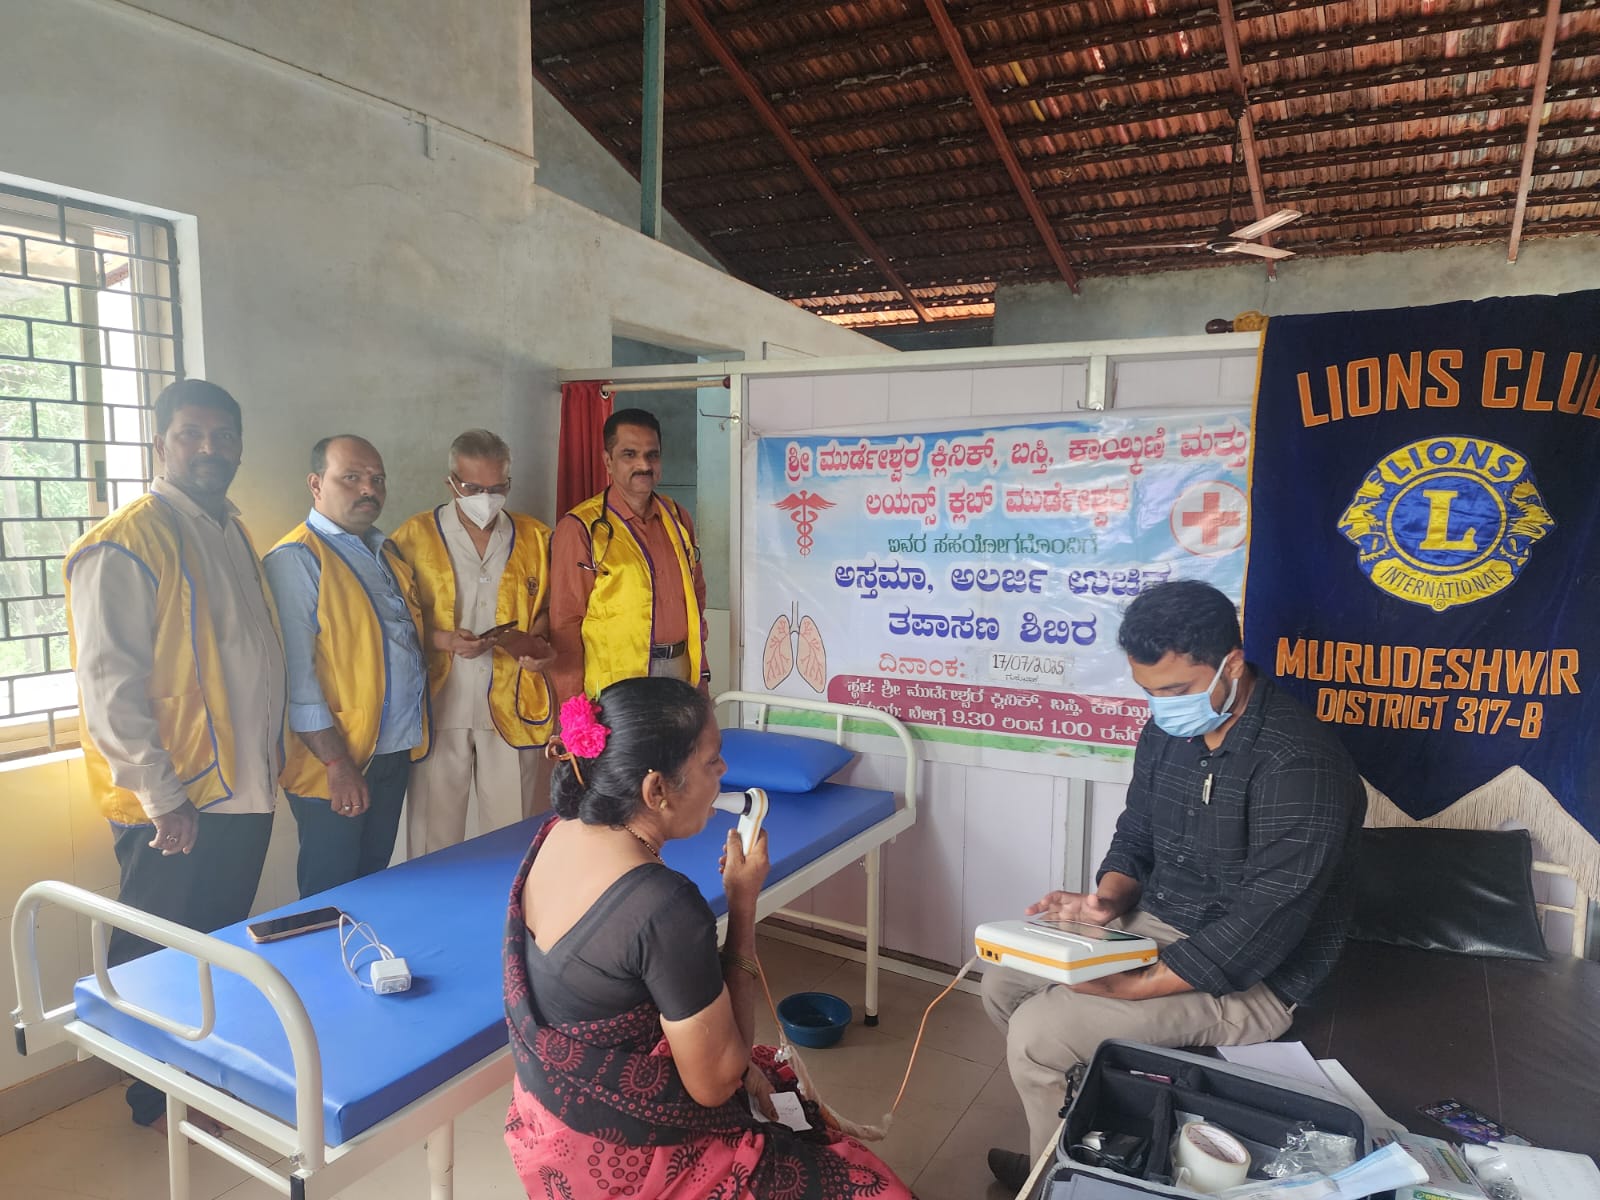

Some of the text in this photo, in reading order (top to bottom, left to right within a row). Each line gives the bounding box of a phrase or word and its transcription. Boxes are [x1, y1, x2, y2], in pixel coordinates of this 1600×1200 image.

[1296, 349, 1463, 428] LIONS
[787, 446, 810, 482] ಶ್ರೀ
[1011, 440, 1054, 474] ಬಸ್ತಿ,
[1181, 424, 1247, 468] ಮತ್ತು
[1384, 440, 1517, 480] LIONS
[866, 486, 936, 525] ಲಯನ್ಸ್
[949, 485, 993, 524] ಕ್ಲಬ್
[1420, 489, 1477, 552] L
[1380, 566, 1506, 599] INTERNATIONAL
[1020, 612, 1097, 646] ಶಿಬಿರ
[992, 654, 1065, 676] 17/07/2025
[1276, 637, 1581, 695] MURUDESHWR
[881, 679, 901, 699] ಶ್ರೀ
[952, 709, 995, 727] 9.30
[1051, 719, 1092, 737] 1.00
[1316, 687, 1544, 739] DISTRICT 317-B
